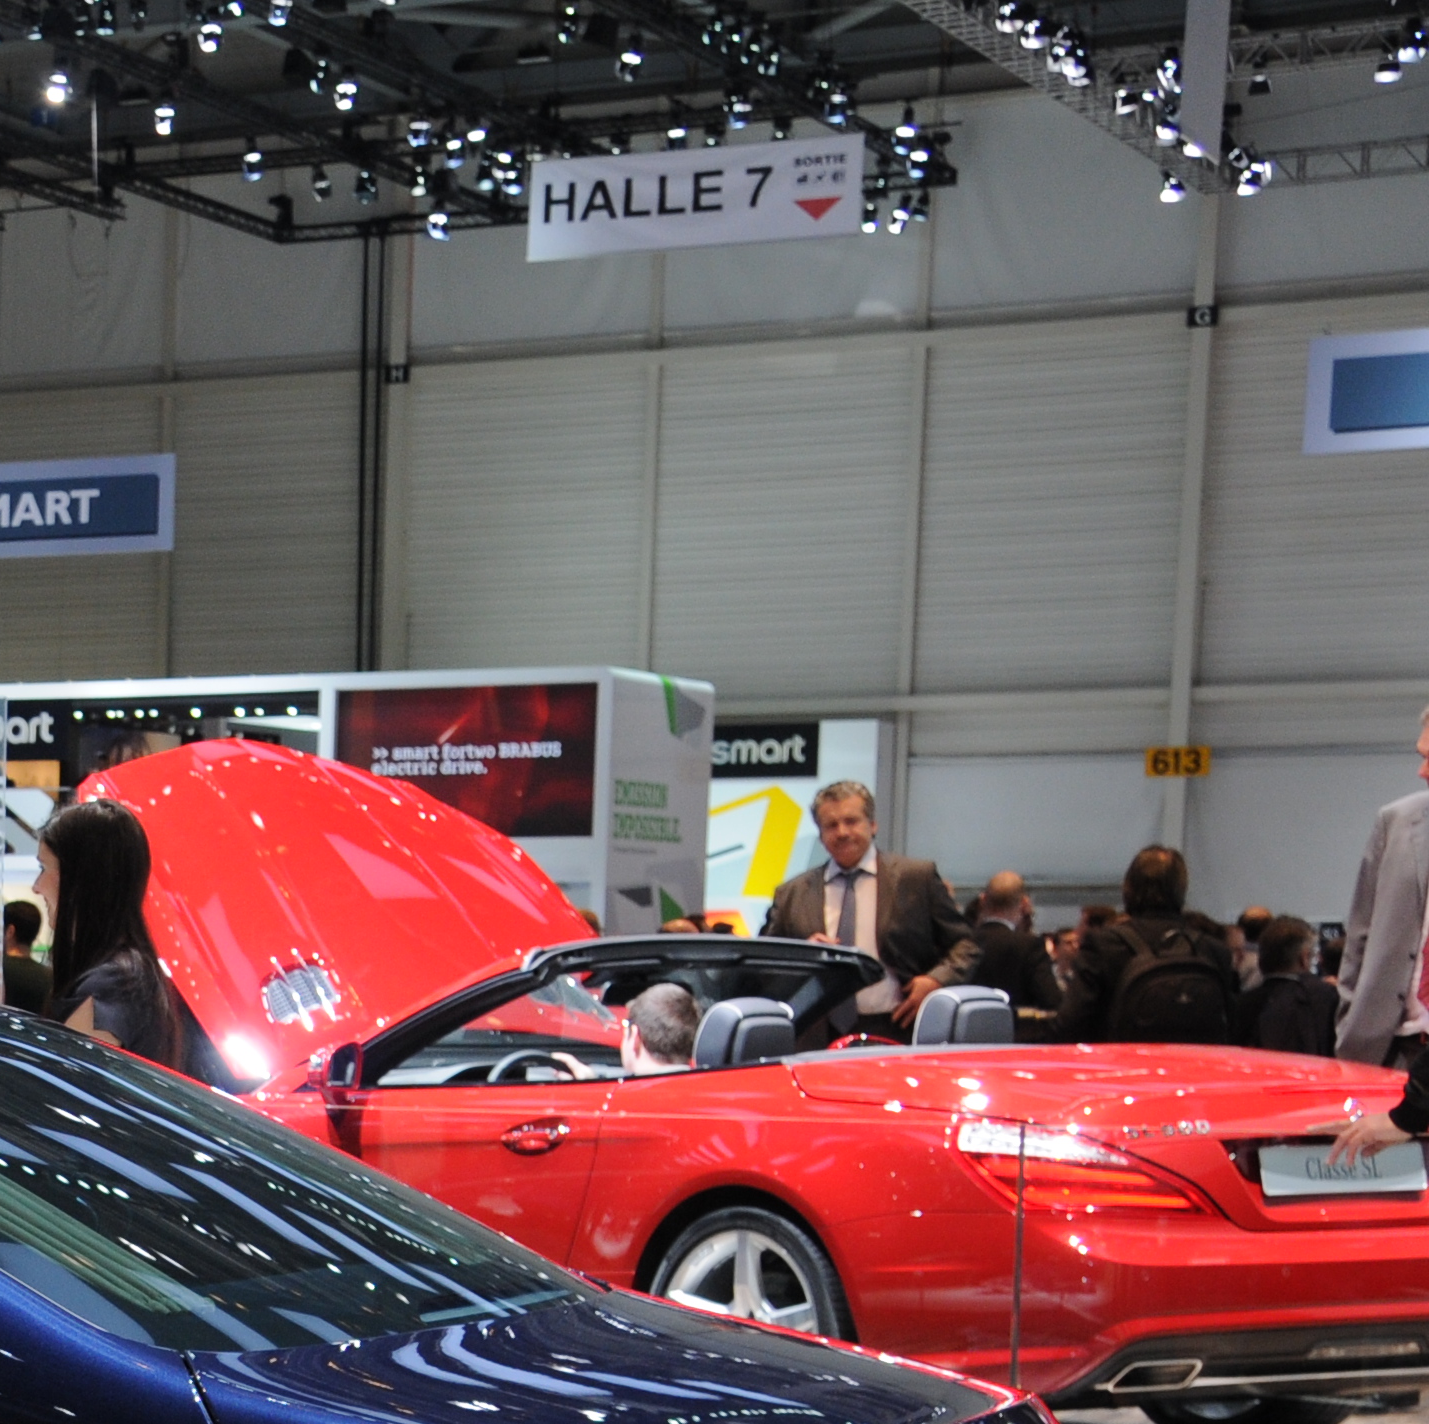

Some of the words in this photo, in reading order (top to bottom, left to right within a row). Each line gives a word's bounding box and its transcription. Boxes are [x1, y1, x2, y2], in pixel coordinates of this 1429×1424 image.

[543, 169, 725, 223] HALLE
[745, 165, 774, 207] 7
[392, 743, 439, 761] smart
[441, 742, 496, 760] fortwo
[498, 740, 563, 759] BRABUS
[712, 733, 806, 766] smart
[1152, 749, 1201, 776] 613
[370, 758, 438, 776] electric
